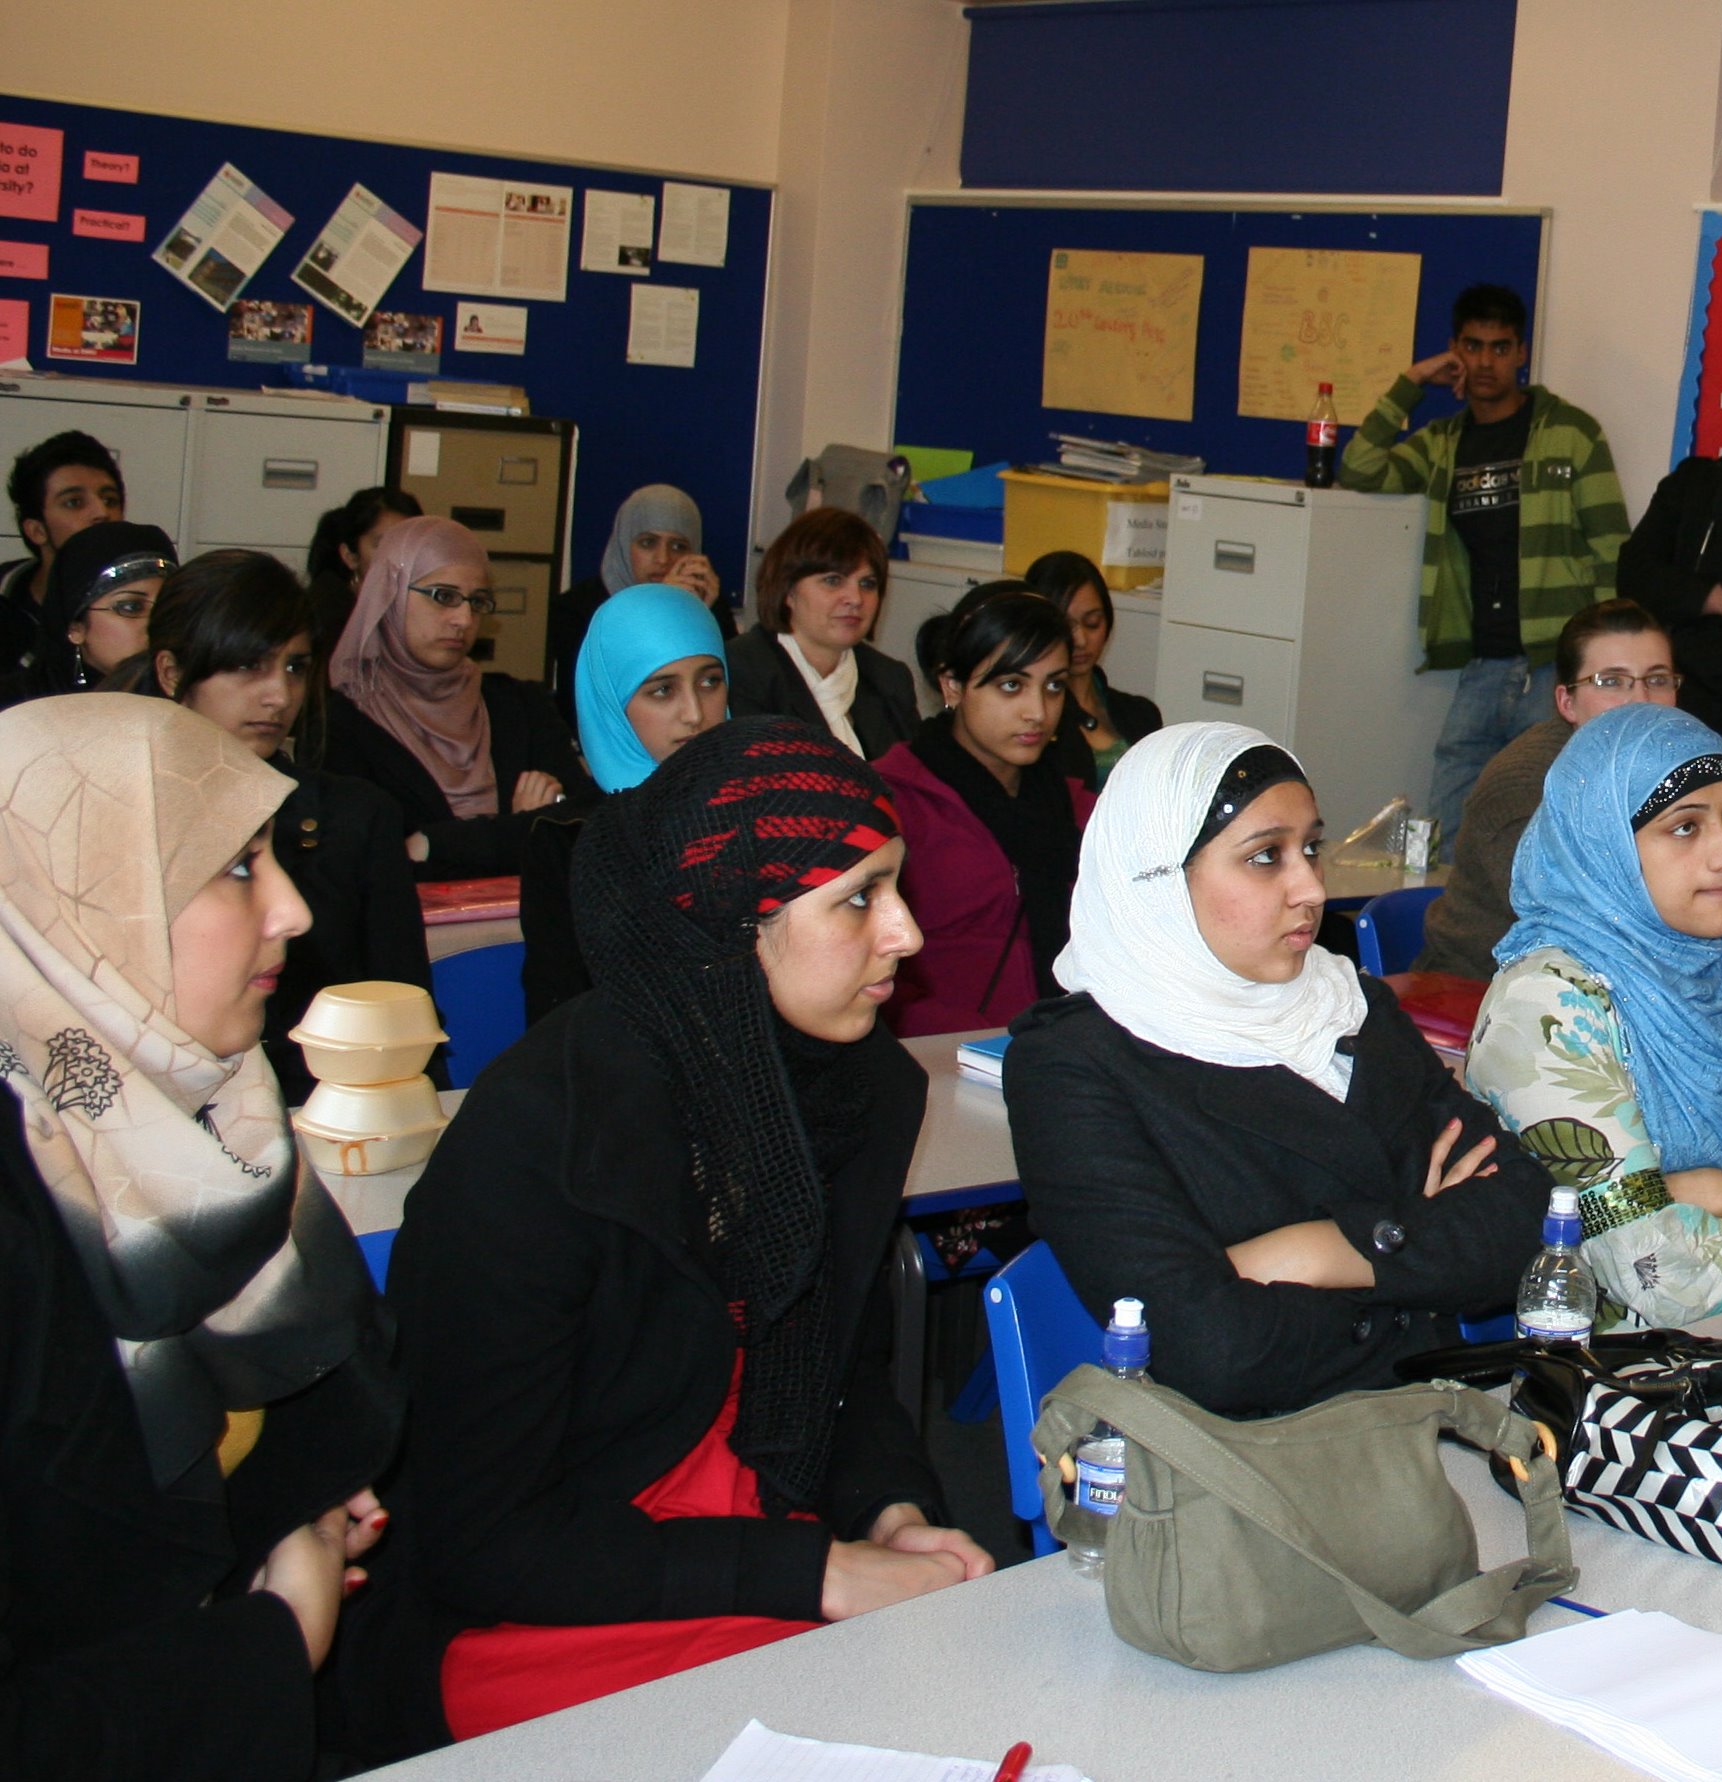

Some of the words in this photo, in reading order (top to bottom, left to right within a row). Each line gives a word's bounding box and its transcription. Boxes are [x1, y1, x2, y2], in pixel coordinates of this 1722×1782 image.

[18, 144, 38, 158] do
[15, 162, 30, 176] at
[90, 158, 130, 172] Theory?
[1127, 518, 1153, 529] Media
